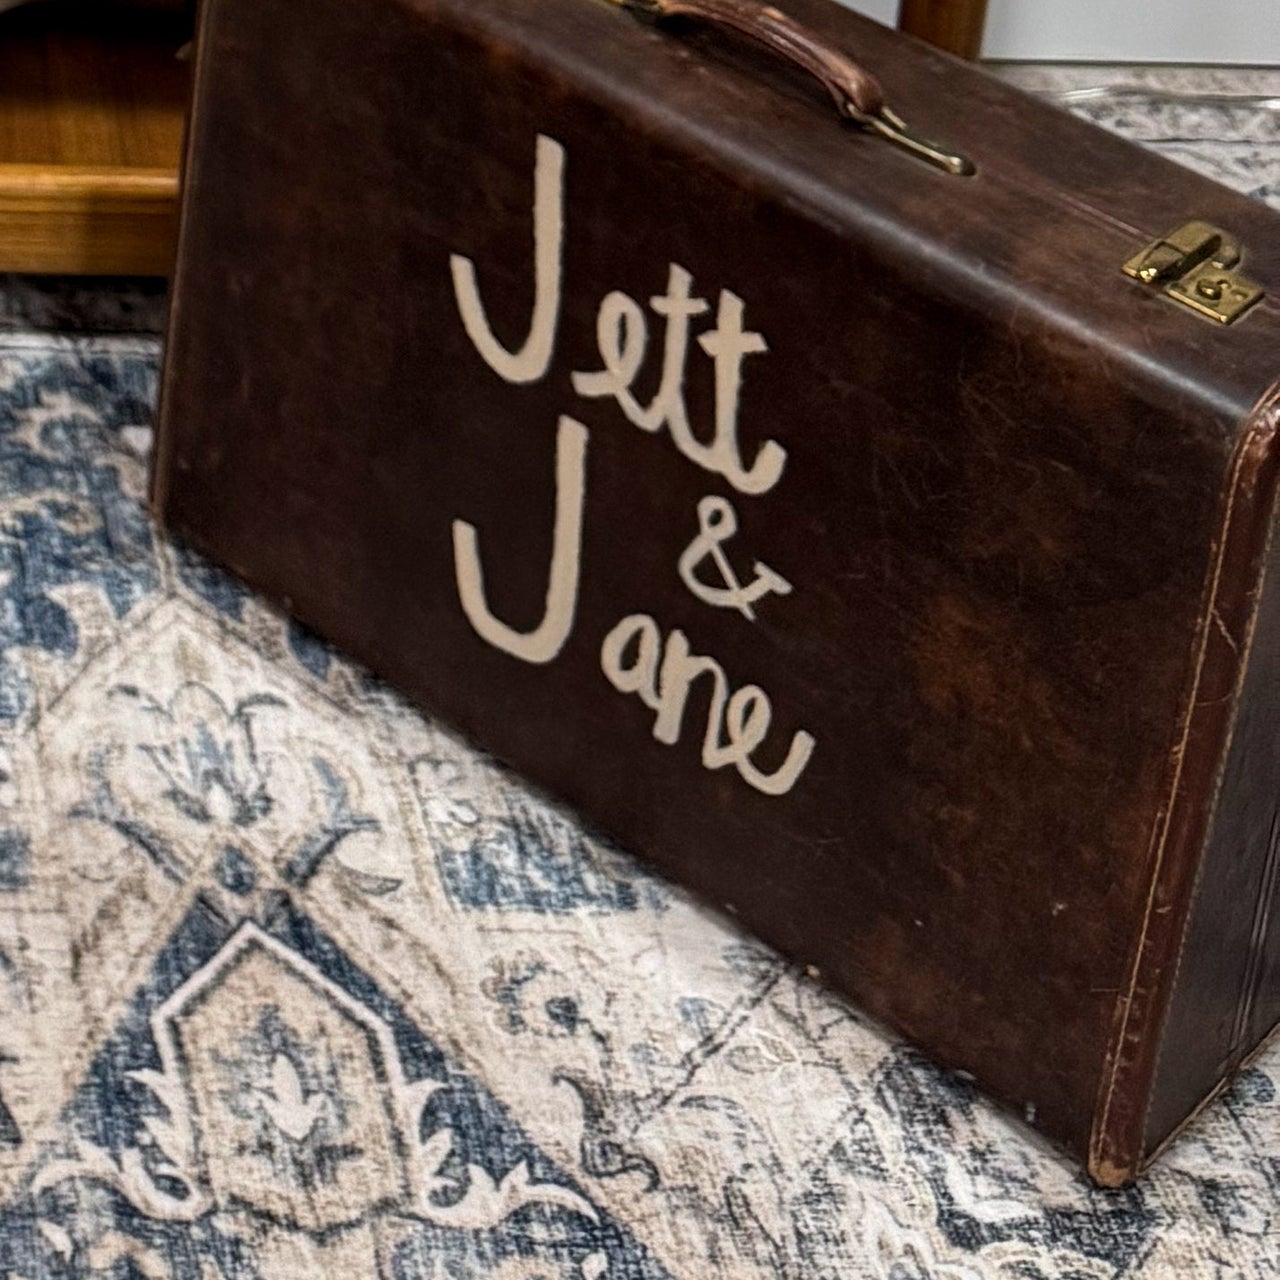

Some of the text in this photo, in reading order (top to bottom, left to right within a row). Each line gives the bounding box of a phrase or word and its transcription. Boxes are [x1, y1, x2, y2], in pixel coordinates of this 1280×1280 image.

[449, 132, 788, 496] Jett
[452, 414, 817, 796] Jane
[678, 495, 793, 622] &
